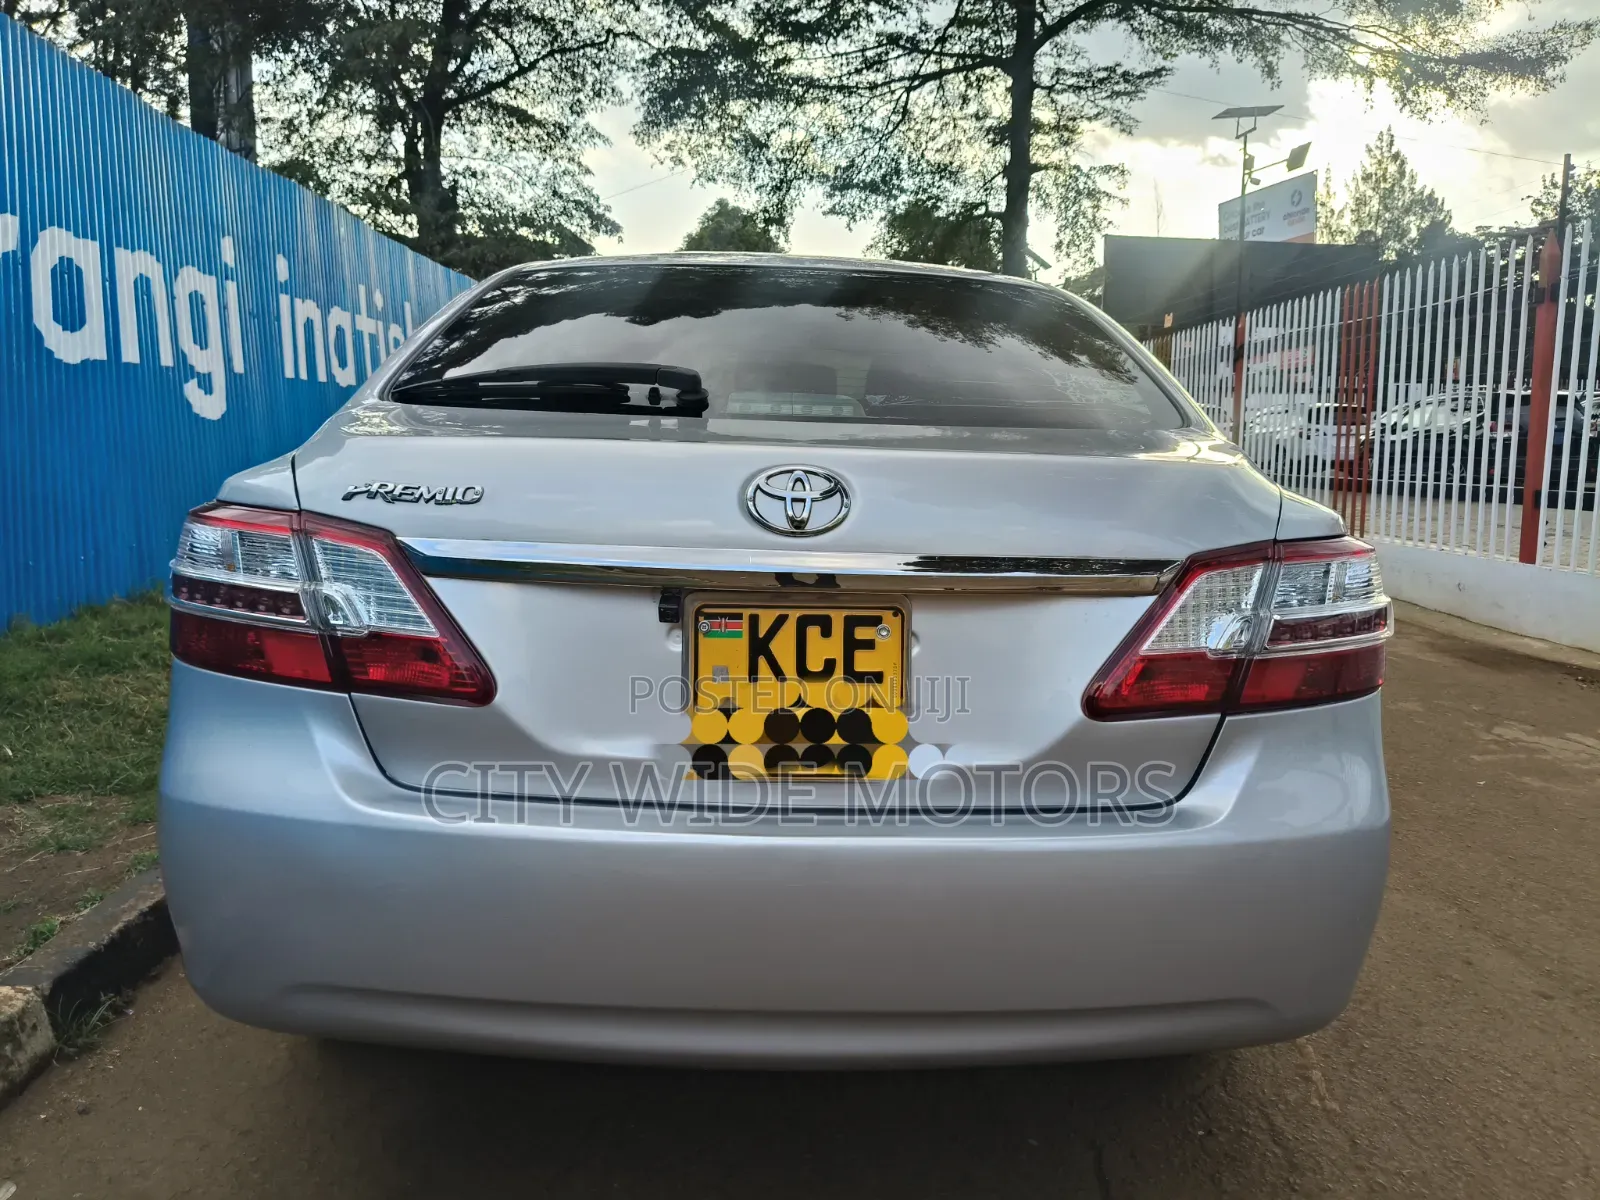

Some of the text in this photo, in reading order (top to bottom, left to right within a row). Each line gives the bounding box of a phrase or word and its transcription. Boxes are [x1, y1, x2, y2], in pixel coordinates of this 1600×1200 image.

[0, 212, 244, 419] angi
[341, 480, 485, 505] PREMIO
[748, 613, 884, 684] KCE
